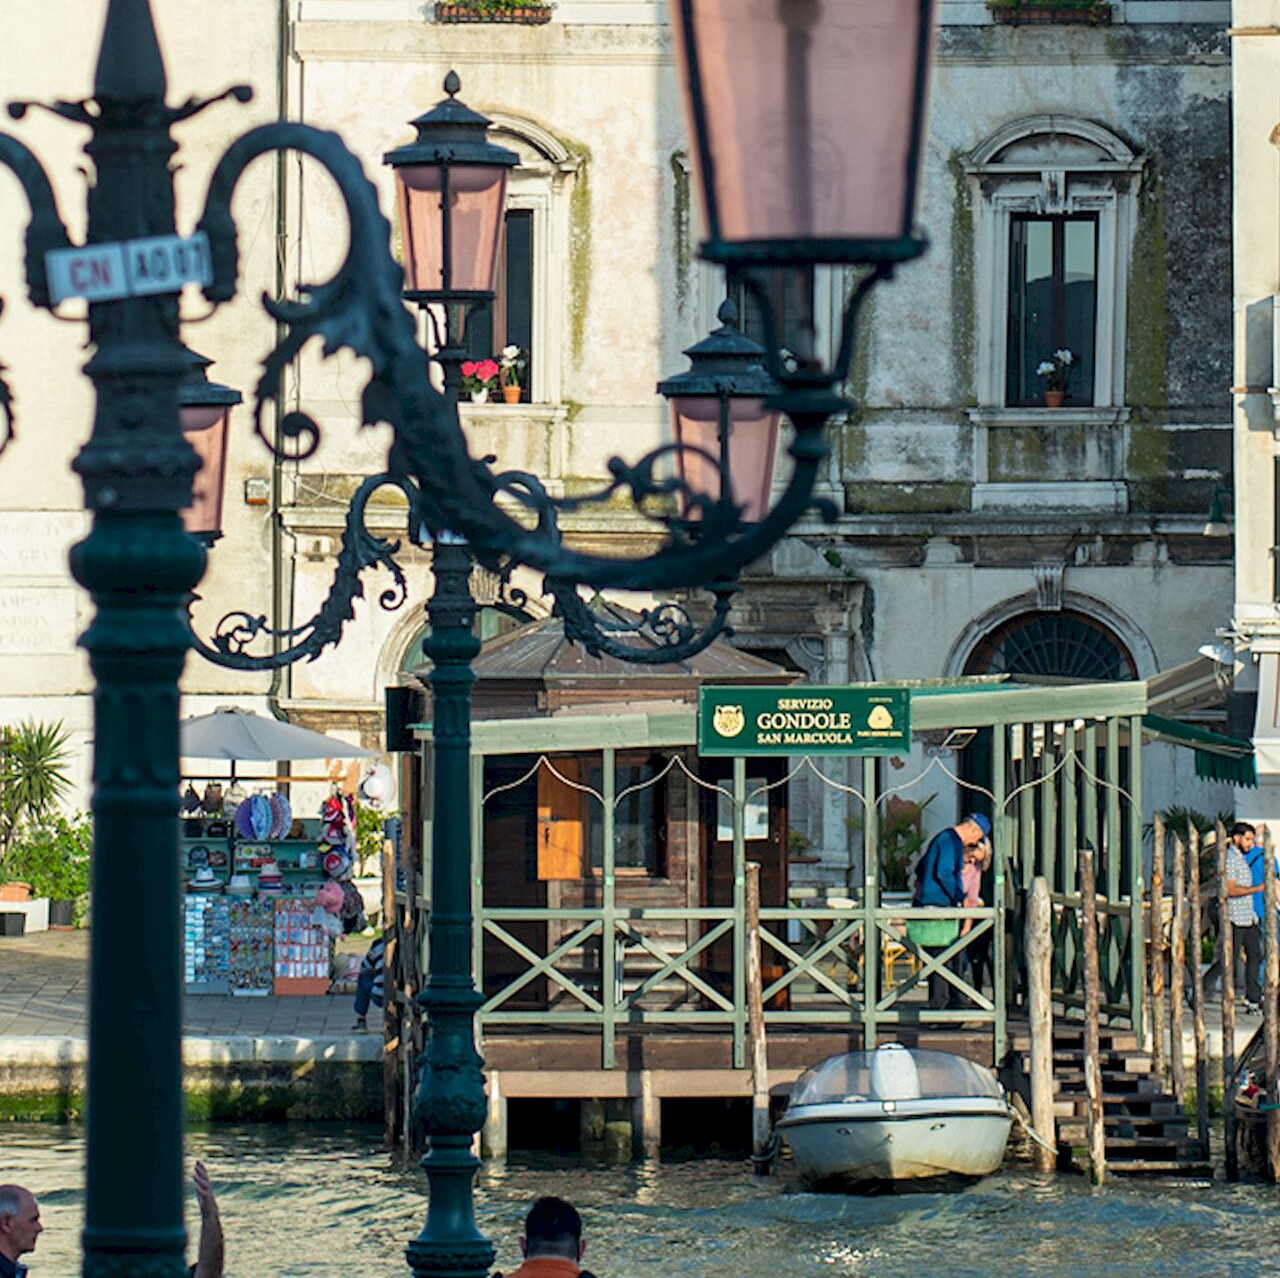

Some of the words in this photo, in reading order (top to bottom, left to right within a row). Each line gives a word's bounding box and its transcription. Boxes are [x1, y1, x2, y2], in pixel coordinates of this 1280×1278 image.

[70, 258, 111, 292] CN
[777, 698, 833, 710] SERVIZIO
[757, 713, 851, 729] GONDOLE
[757, 733, 781, 743] SAN
[784, 733, 853, 744] MARCUOLA
